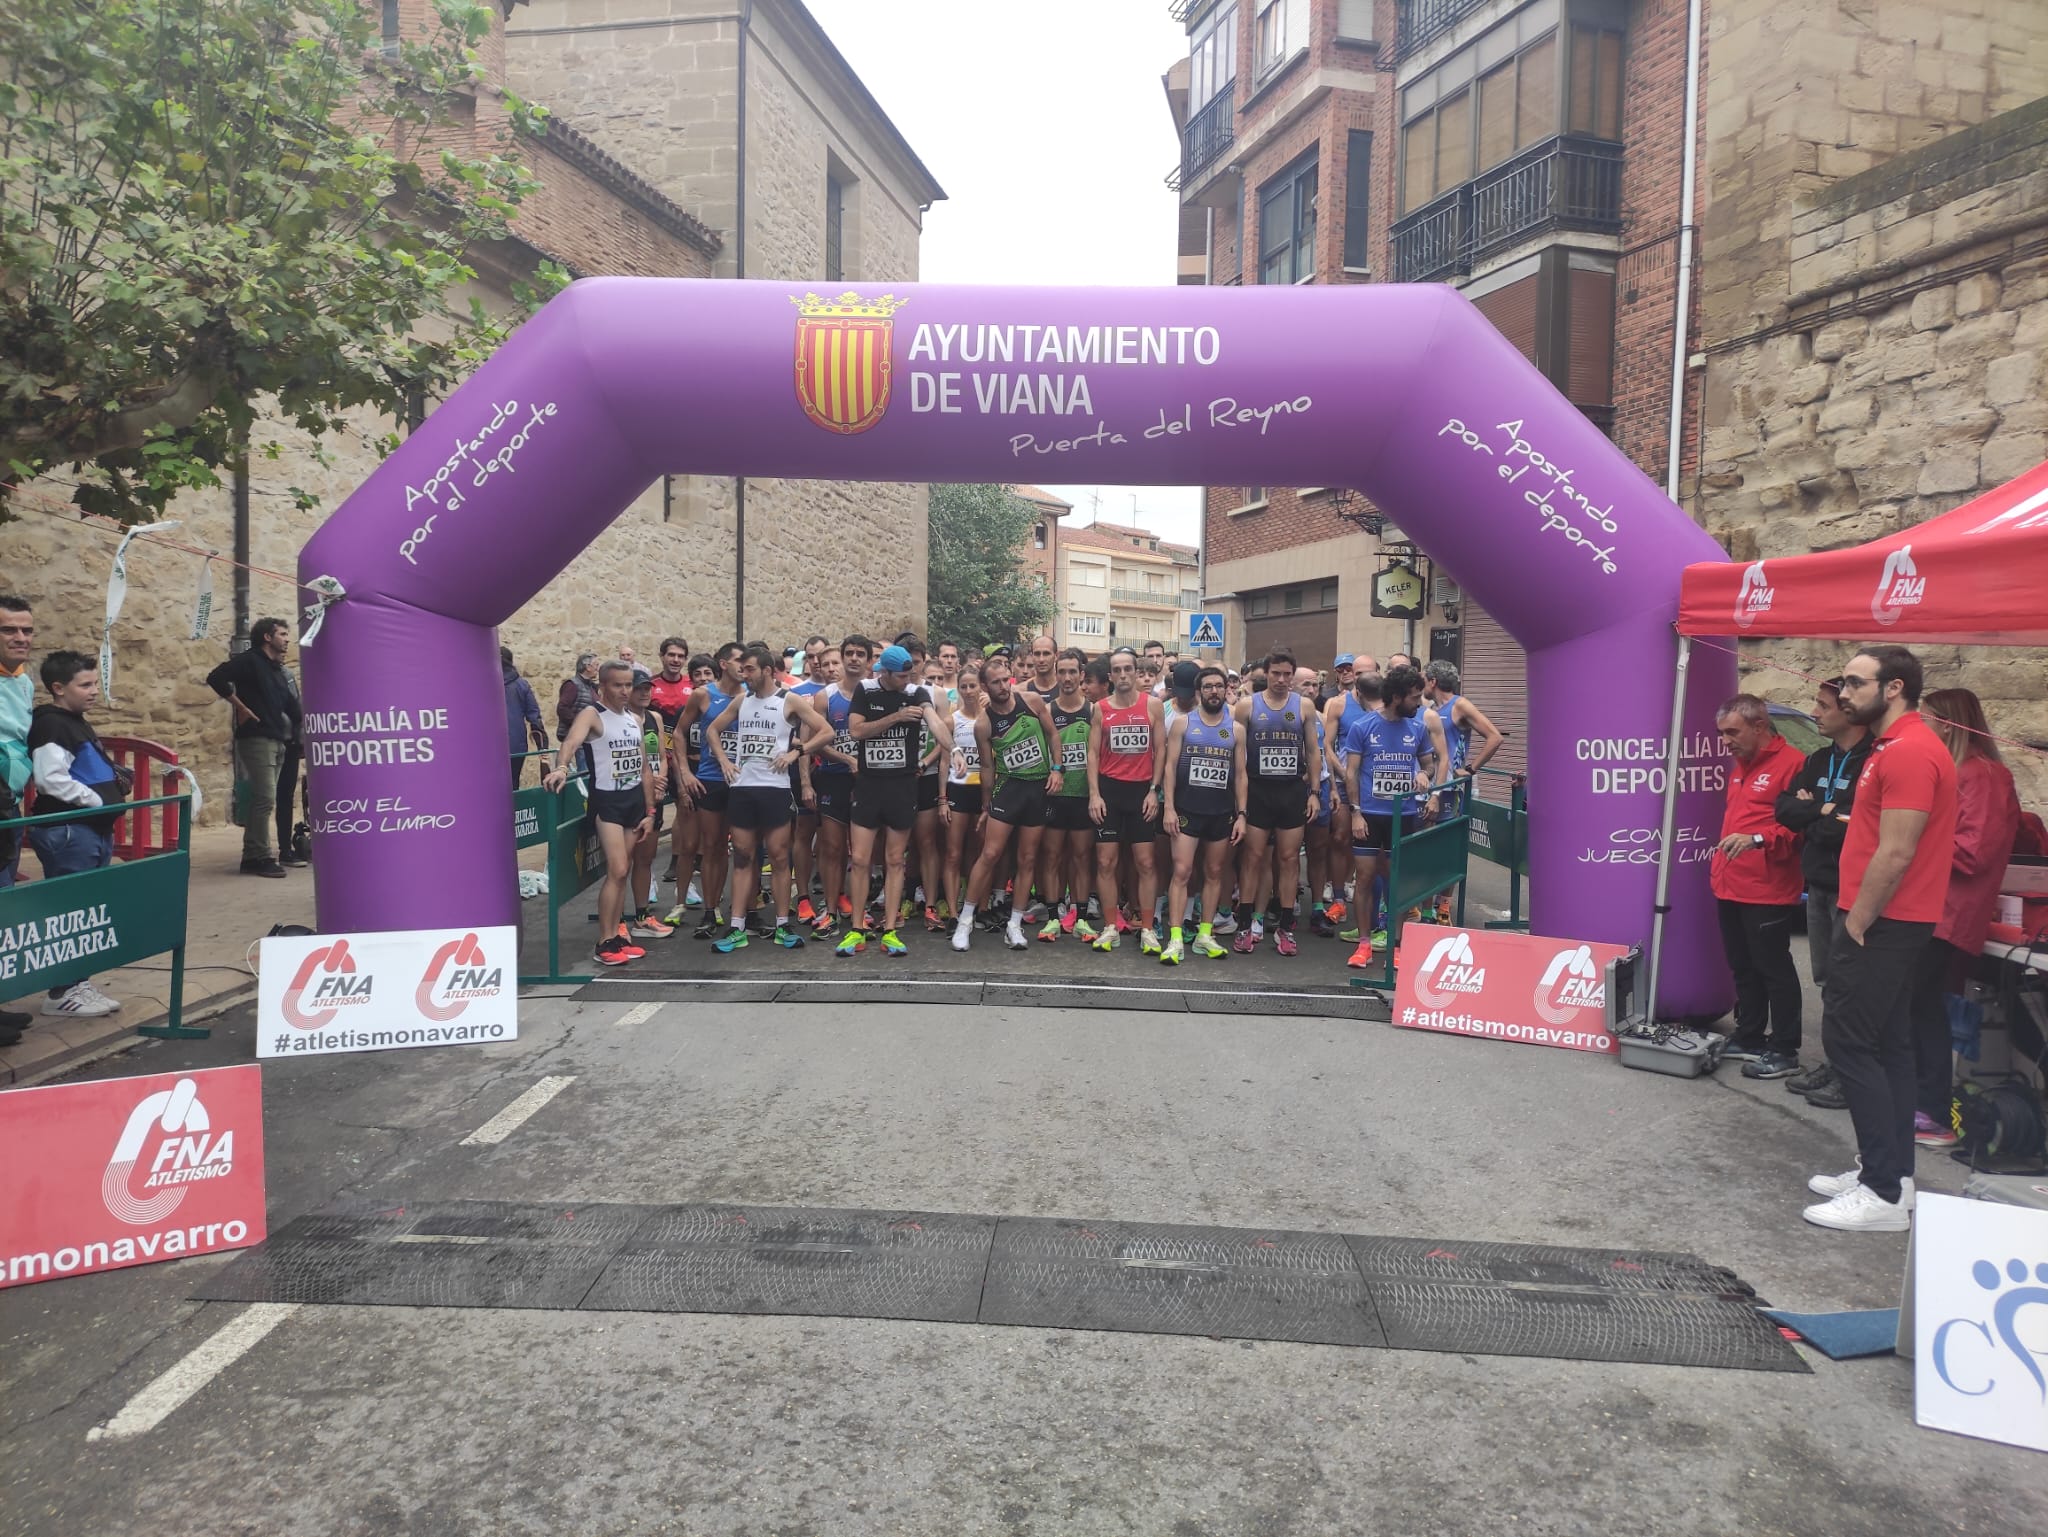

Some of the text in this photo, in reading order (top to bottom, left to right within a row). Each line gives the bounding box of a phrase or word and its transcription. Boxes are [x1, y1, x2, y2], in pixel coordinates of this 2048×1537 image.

[908, 323, 1220, 365] AYUNTAMIENTO
[910, 371, 1094, 416] DE VIANA
[1009, 395, 1312, 457] Puerta del Reyno
[405, 400, 518, 512] Apostando
[400, 402, 558, 566] por el deporte
[1496, 419, 1618, 533] Apostando
[1438, 418, 1617, 574] por el deporte
[1385, 582, 1412, 595] KELER
[1748, 587, 1775, 604] FNA
[1891, 576, 1926, 597] FNA
[304, 705, 449, 734] CONCEJALÍA DE
[742, 743, 775, 755] 1027
[836, 741, 859, 754] 034
[1113, 734, 1148, 746] 1030
[312, 737, 434, 766] DEPORTES
[868, 749, 905, 761] 1023
[1007, 746, 1040, 766] 1025
[1062, 752, 1085, 764] 029
[1373, 749, 1413, 762] adentro
[613, 757, 642, 771] 1036
[1262, 756, 1296, 768] 1032
[1192, 767, 1227, 781] 1028
[1374, 780, 1410, 793] 1040
[325, 796, 411, 814] CON EL
[313, 814, 456, 834] JUEGO LIMPIO
[1675, 826, 1707, 842] EL
[0, 904, 112, 953] AJA RURAL
[23, 926, 119, 974] NAVARRA
[446, 967, 502, 990] FNA
[1439, 964, 1486, 986] FNA
[315, 975, 373, 998] FNA
[442, 987, 501, 1000] ATLETISMO
[1435, 981, 1483, 994] ATLETISMO
[1560, 978, 1606, 1000] FNA
[309, 995, 372, 1008] ATLETISMO
[1556, 995, 1606, 1009] ATLETISMO
[1402, 1006, 1612, 1049] #atletismonavarro
[274, 1023, 504, 1054] #atletismonavarro
[151, 1130, 234, 1173] FNA
[144, 1162, 232, 1188] ATLETISMO
